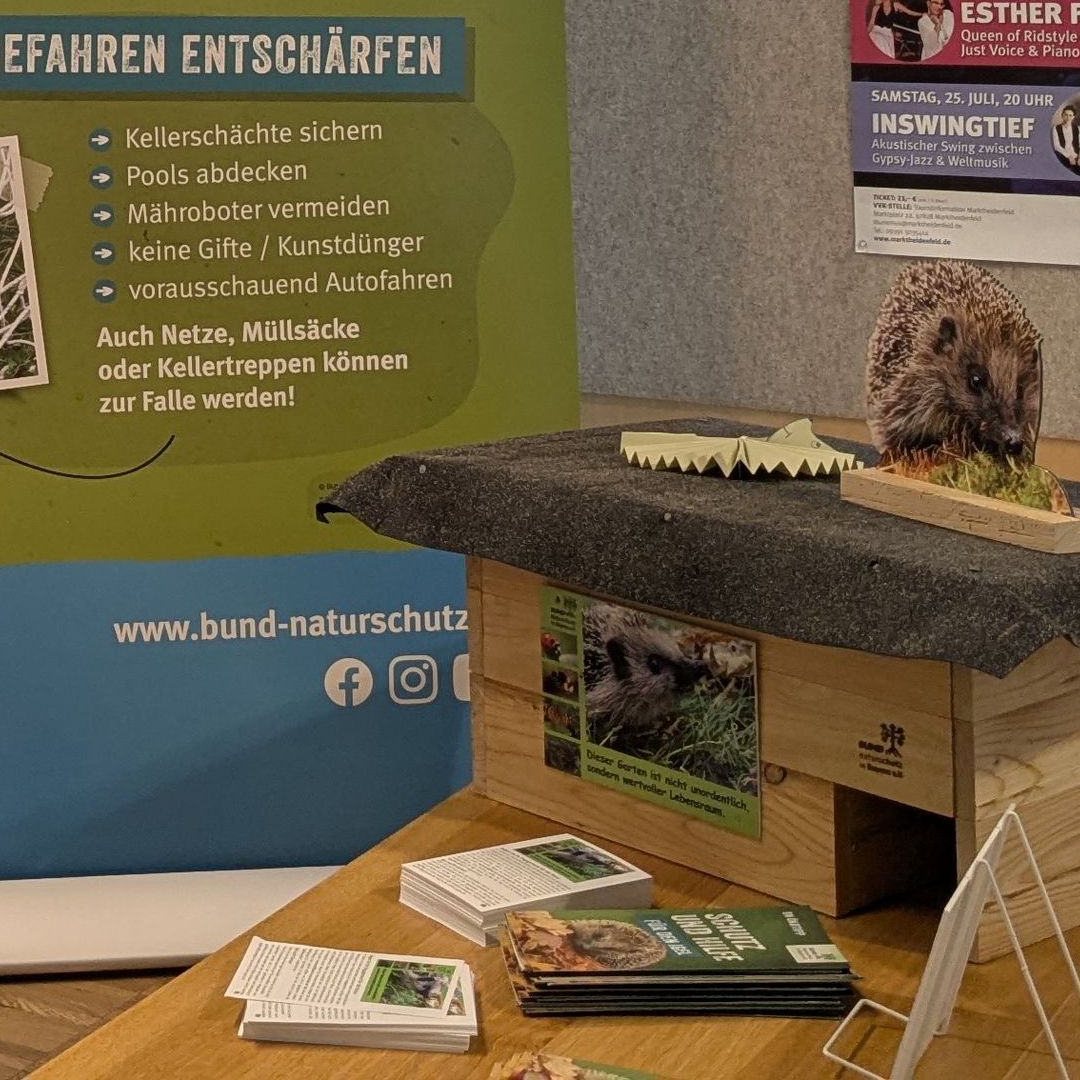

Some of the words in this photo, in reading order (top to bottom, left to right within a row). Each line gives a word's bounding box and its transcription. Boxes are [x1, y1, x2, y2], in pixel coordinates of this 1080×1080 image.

[961, 1, 1062, 24] ESTHER
[182, 26, 441, 75] ENTSCHÄRFEN
[960, 29, 1003, 43] Queen
[1006, 29, 1021, 42] of
[1024, 29, 1078, 46] Ridstyle
[961, 43, 986, 57] Just
[988, 43, 1025, 57] Voice
[1028, 45, 1039, 57] &
[1042, 44, 1080, 58] Piano
[871, 89, 941, 105] SAMSTAG,
[944, 92, 965, 104] 25.
[967, 92, 1000, 107] JULI,
[1003, 93, 1020, 106] 20
[1024, 94, 1054, 107] UHR
[126, 122, 292, 149] Kellerschächte
[300, 119, 382, 143] sichern
[872, 113, 1035, 139] INSWINGTIEF
[871, 138, 939, 151] Akustischer
[941, 140, 976, 155] Swing
[978, 142, 1032, 155] zwischen
[872, 152, 933, 167] Gypsy-Jazz
[936, 155, 945, 166] &
[947, 155, 1009, 169] Weltmusik
[127, 163, 189, 186] Pools
[196, 159, 307, 184] abdecken
[128, 200, 263, 224] Mähroboter
[267, 194, 390, 219] vermeiden
[129, 239, 191, 262] keine
[198, 237, 252, 260] Gifte
[260, 234, 270, 261] /
[278, 232, 425, 258] Kunstdünger
[128, 271, 318, 300] vorausschauend
[325, 268, 452, 293] Autofahren
[96, 324, 154, 348] Auch
[162, 324, 235, 347] Netze,
[242, 317, 360, 343] Müllsäcke
[98, 358, 152, 380] oder
[158, 355, 315, 380] Kellertreppen
[323, 350, 408, 372] können
[99, 396, 137, 413] zur
[142, 389, 196, 412] Falle
[201, 385, 295, 409] werden!
[113, 604, 469, 643] www.bund-naturschutz
[586, 748, 615, 766] Dieser
[650, 769, 662, 782] ist
[664, 777, 688, 791] nicht
[586, 764, 620, 782] sondern
[622, 777, 667, 796] wertvoller
[671, 914, 712, 935] UND
[704, 912, 767, 951] SCHUTZ
[691, 936, 745, 962] HILFE
